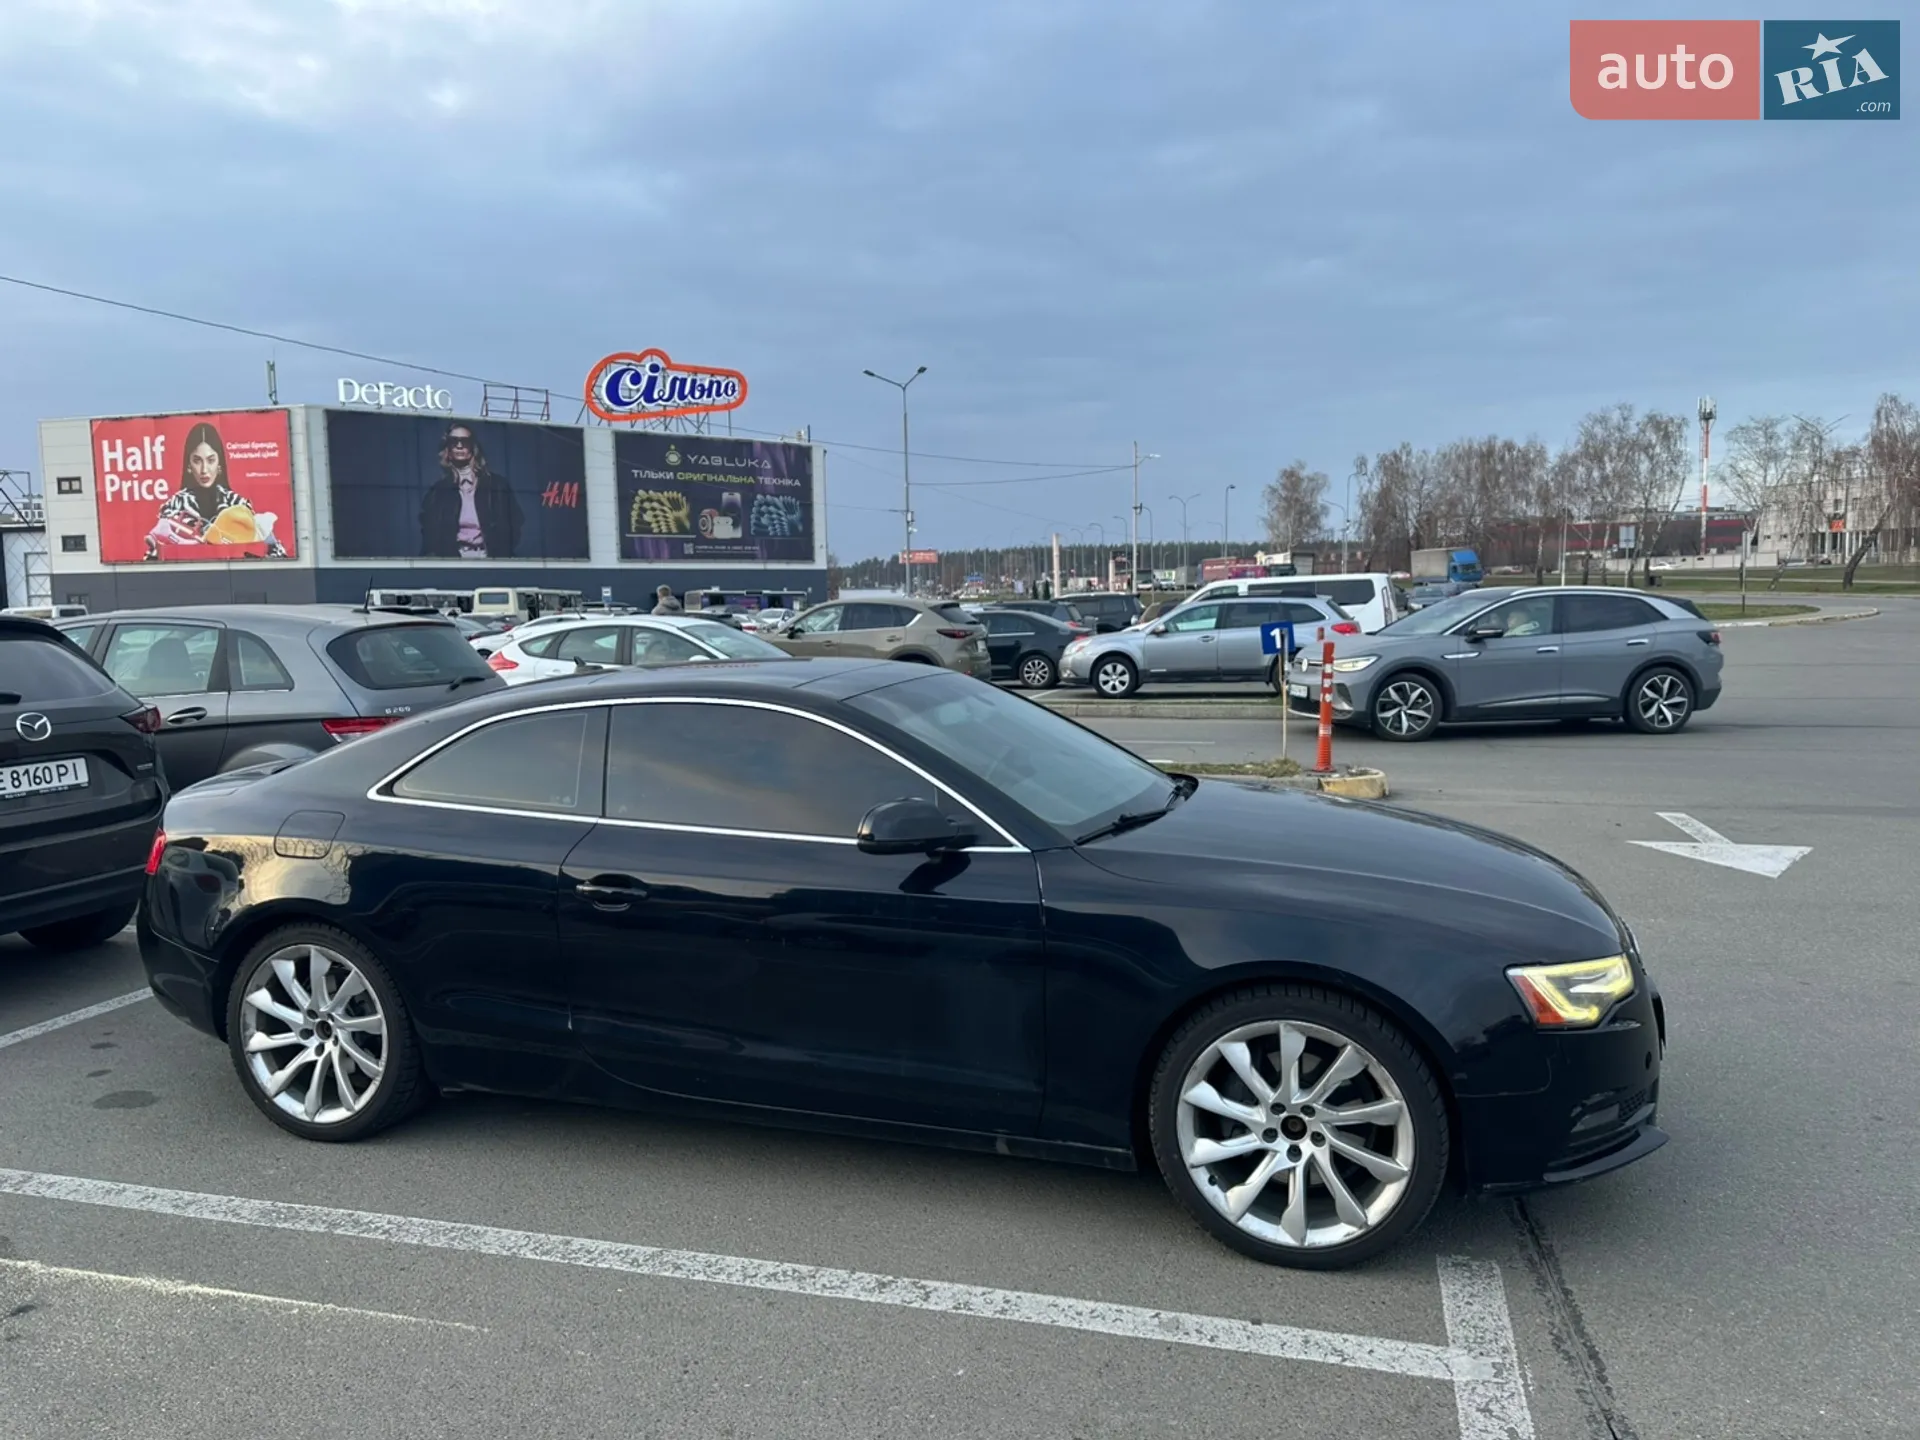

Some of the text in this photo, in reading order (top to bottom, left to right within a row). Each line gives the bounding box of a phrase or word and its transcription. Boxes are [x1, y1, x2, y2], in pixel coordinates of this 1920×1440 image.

[337, 377, 452, 409] DeFacto
[604, 362, 738, 408] Сільпо
[102, 434, 165, 472] Half
[687, 454, 772, 469] YABLUKA
[104, 473, 169, 503] Price
[631, 469, 801, 487] ТІЛЬКИ ОРИГІНАЛЬНА ТЕХНІКА
[541, 480, 579, 508] H&M
[1269, 627, 1282, 649] 1
[10, 765, 53, 789] 8160
[56, 762, 79, 784] PI
